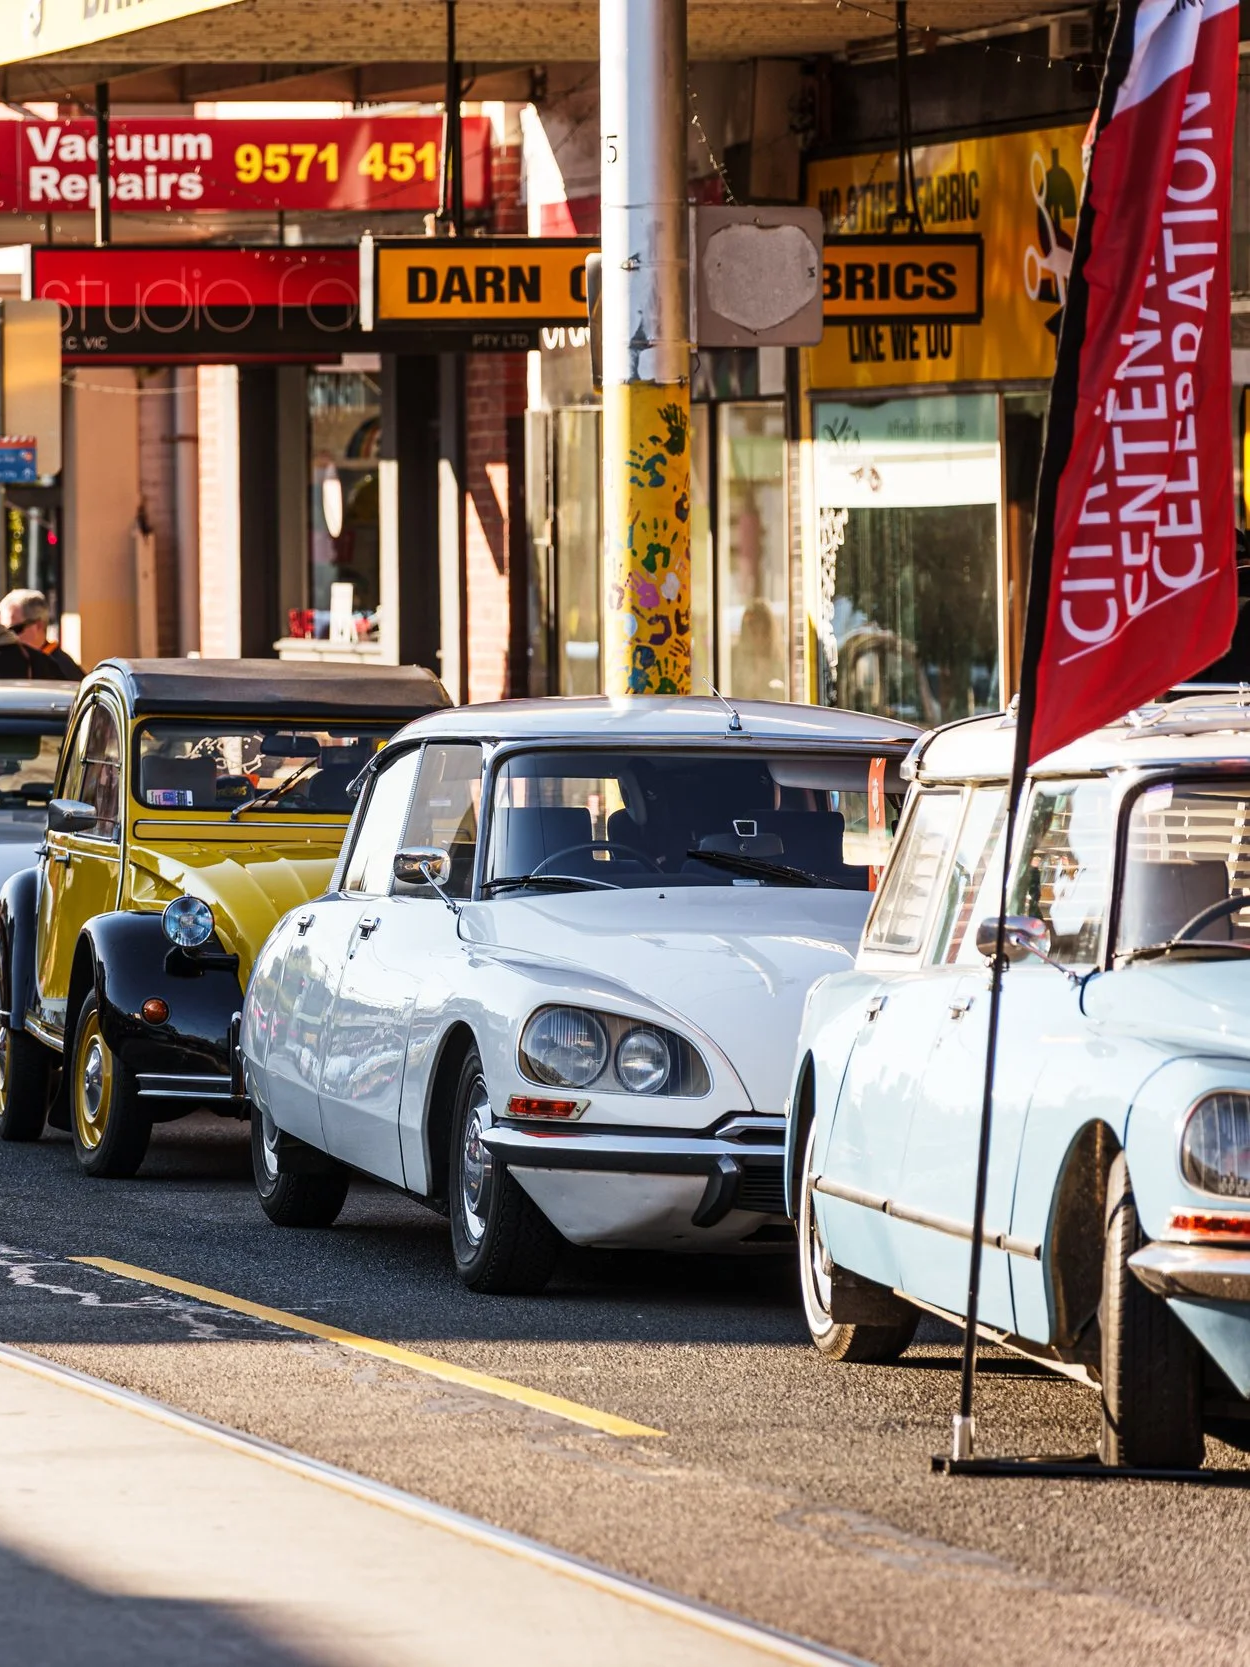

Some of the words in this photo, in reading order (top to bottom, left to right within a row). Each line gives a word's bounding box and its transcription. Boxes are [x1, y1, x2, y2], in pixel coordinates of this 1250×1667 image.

[26, 126, 213, 162] Vacuum
[234, 142, 340, 184] 9571
[28, 166, 205, 209] Repairs
[914, 171, 980, 226] FABRIC
[40, 266, 256, 333] studio
[407, 266, 541, 304] DARN
[848, 323, 885, 364] LIKE
[890, 323, 920, 361] WE
